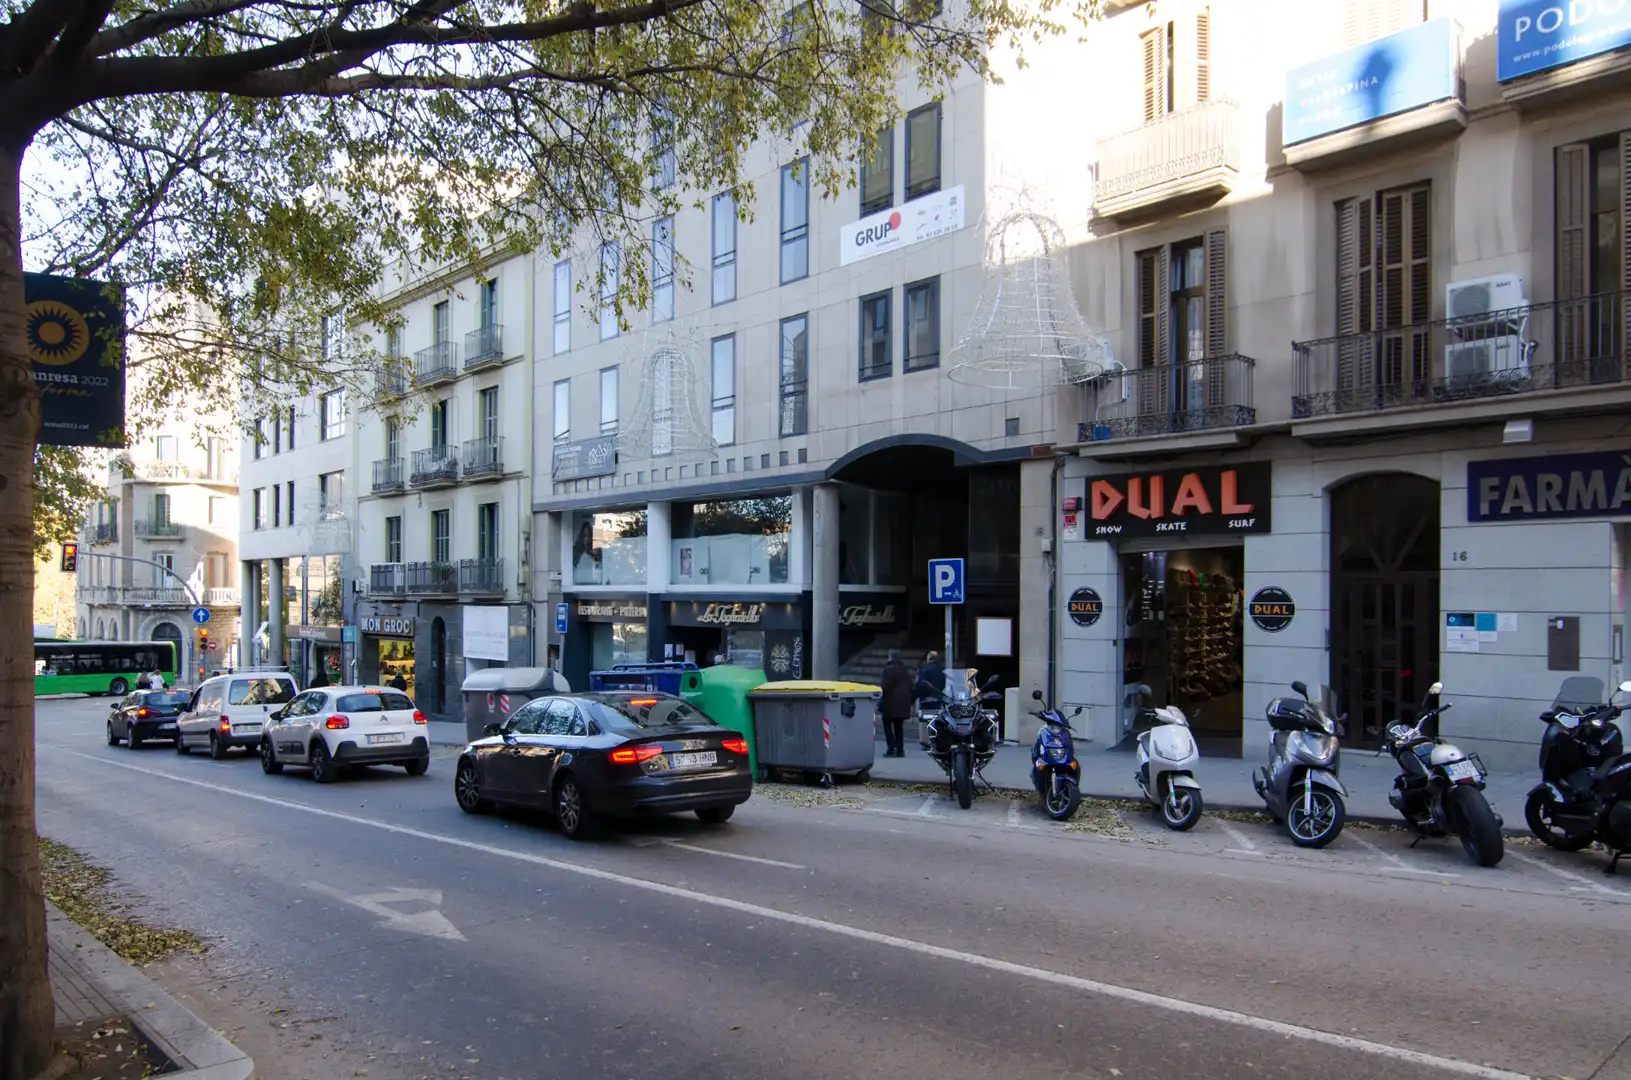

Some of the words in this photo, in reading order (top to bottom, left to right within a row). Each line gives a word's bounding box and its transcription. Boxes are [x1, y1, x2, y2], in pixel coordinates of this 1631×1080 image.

[81, 375, 109, 387] 2022
[1092, 470, 1255, 520] DUAL
[1096, 525, 1122, 535] SNOW
[1156, 521, 1187, 532] SKATE
[1228, 519, 1256, 529] SURF
[1452, 551, 1468, 562] 16
[935, 565, 955, 598] P
[1071, 603, 1097, 612] DUAL
[1254, 604, 1289, 614] DUAL
[361, 618, 380, 631] MON
[384, 619, 410, 634] GROC
[699, 752, 716, 763] HNB
